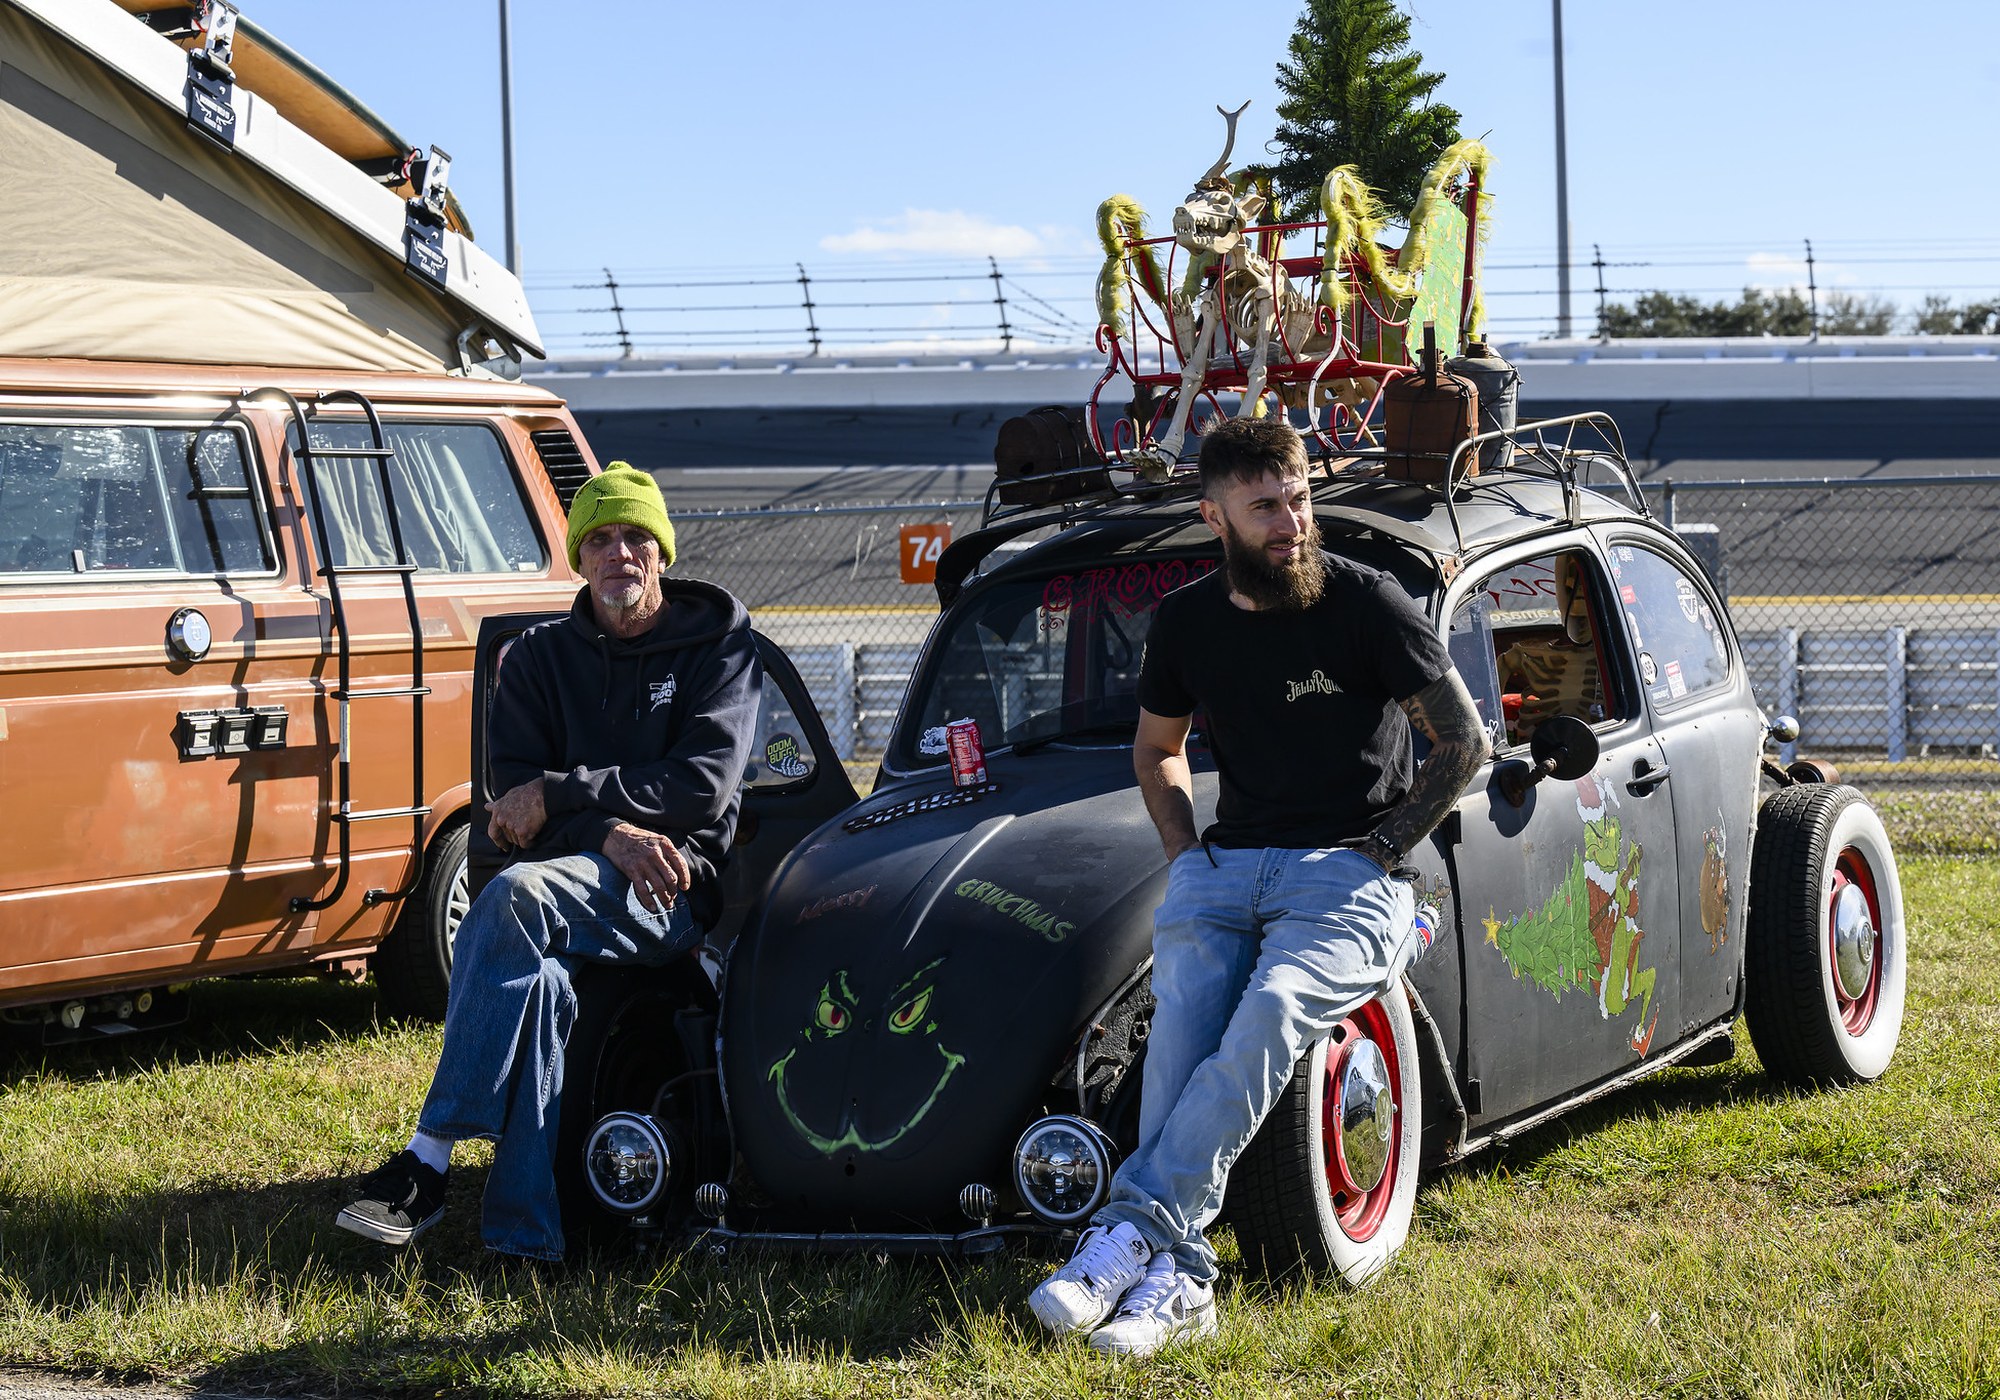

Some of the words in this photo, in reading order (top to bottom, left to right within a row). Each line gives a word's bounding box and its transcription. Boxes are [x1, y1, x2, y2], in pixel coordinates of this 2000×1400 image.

[908, 536, 943, 569] 74
[767, 736, 792, 756] DOOM
[955, 878, 1076, 943] GRINCHMAS
